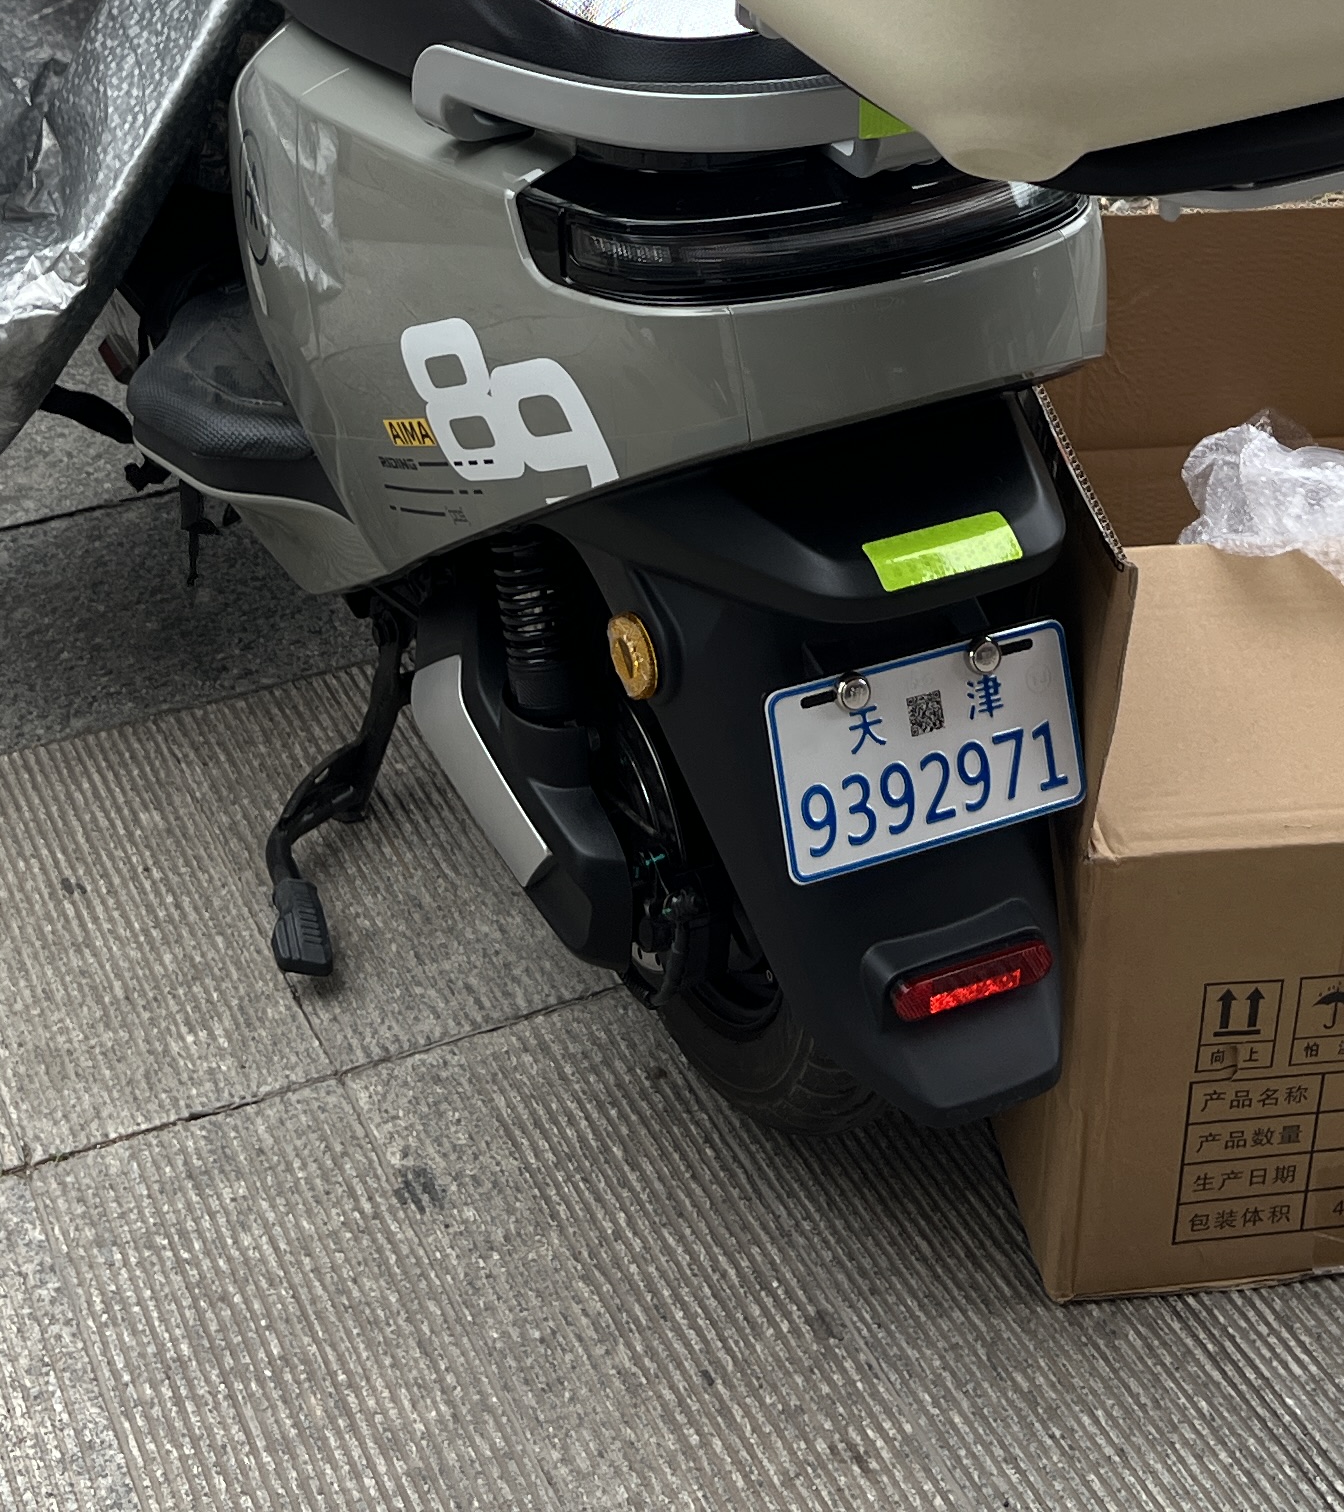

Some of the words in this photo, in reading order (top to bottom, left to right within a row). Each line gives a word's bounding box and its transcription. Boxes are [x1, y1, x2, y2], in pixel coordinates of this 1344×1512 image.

[401, 318, 620, 504] 89
[388, 421, 435, 445] AIMA
[378, 456, 419, 471] RIDING
[848, 705, 887, 755] 天
[966, 674, 1004, 720] 津
[801, 720, 1069, 858] 9392971
[1201, 1085, 1309, 1113] 产品名称
[1195, 1124, 1302, 1154] 产品数量
[1192, 1165, 1297, 1193] 生产日期
[1188, 1204, 1291, 1233] 包装体积
